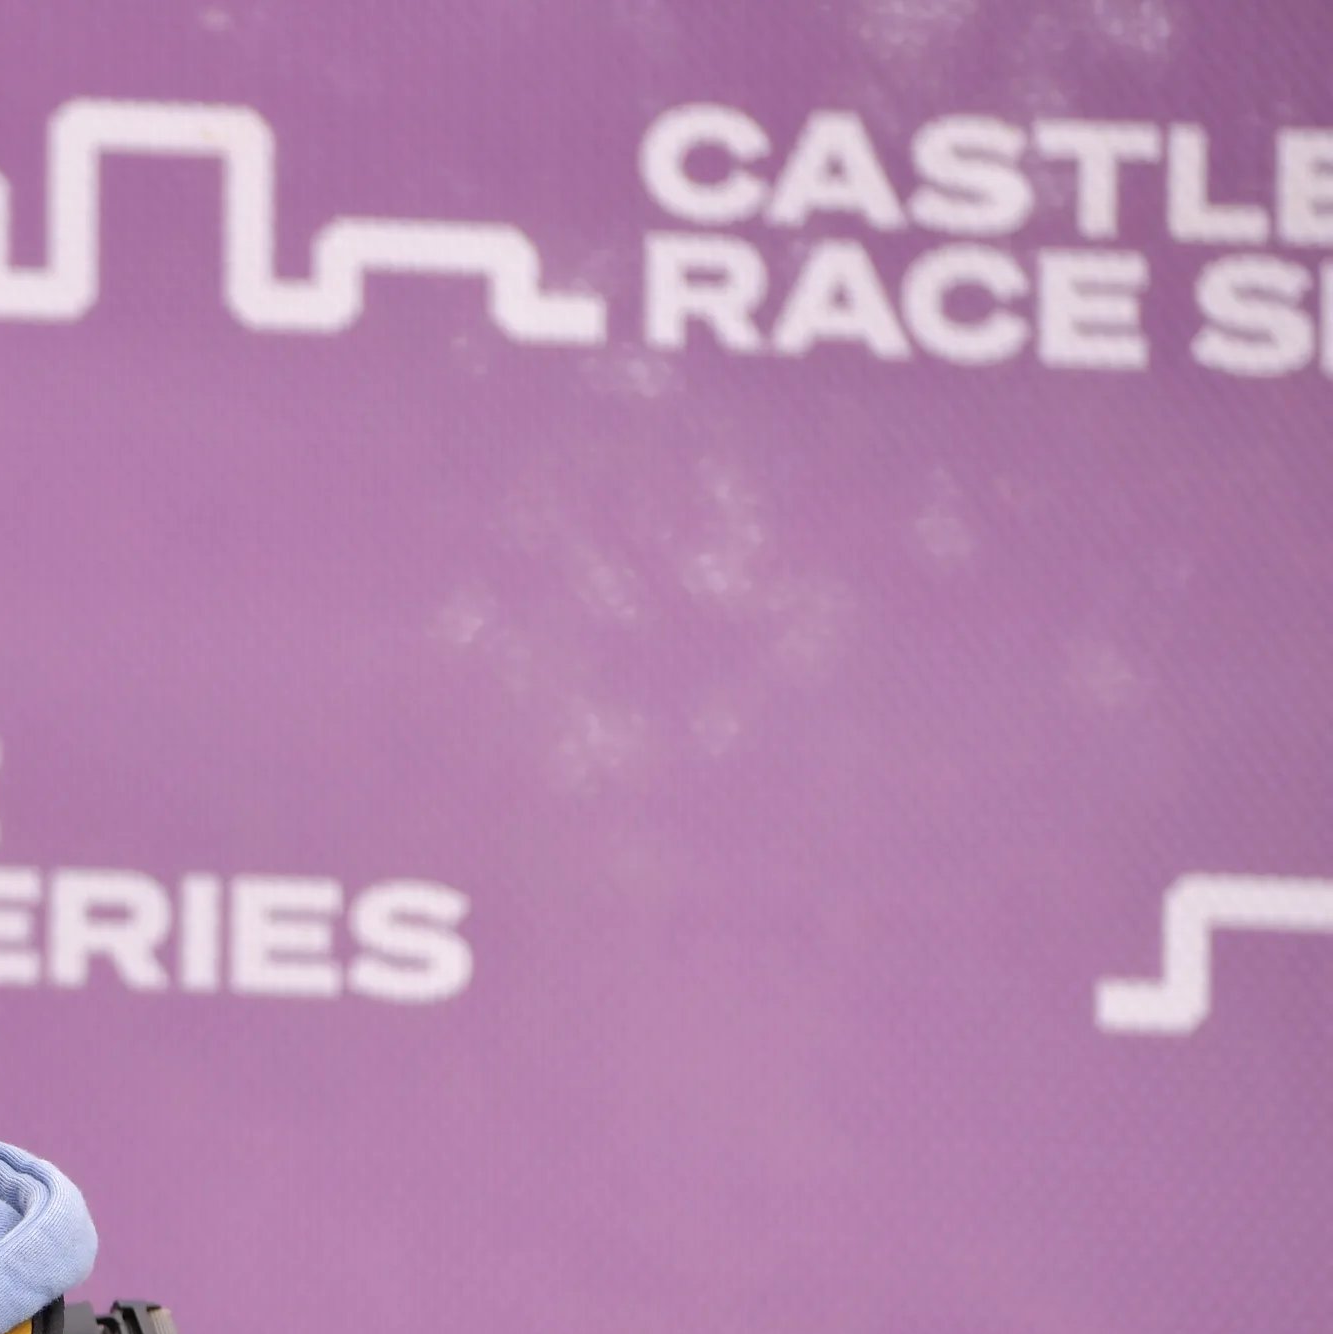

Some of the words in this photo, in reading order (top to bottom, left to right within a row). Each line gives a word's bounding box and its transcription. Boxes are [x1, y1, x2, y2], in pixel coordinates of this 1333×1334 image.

[639, 103, 1333, 248] CASTLE
[641, 231, 1150, 372] RACE
[1191, 253, 1333, 378] S
